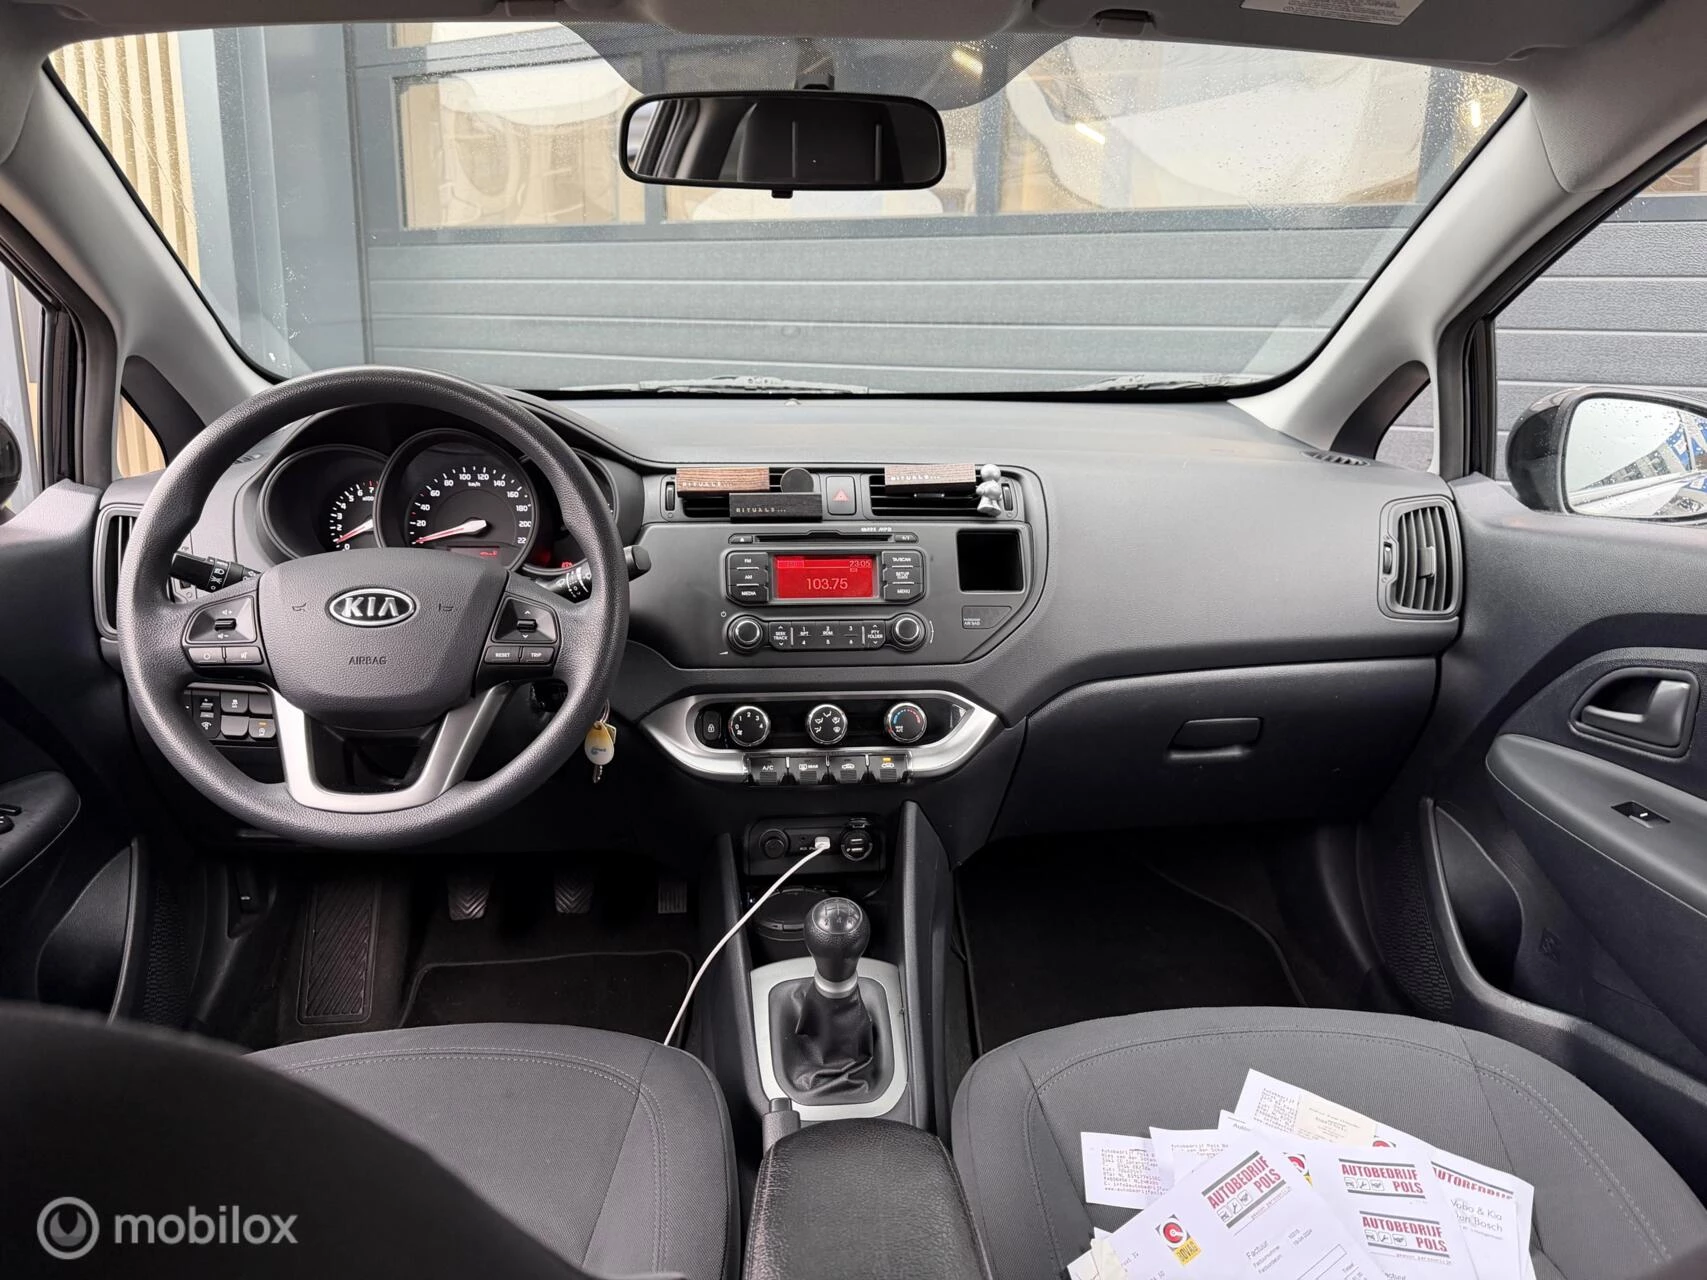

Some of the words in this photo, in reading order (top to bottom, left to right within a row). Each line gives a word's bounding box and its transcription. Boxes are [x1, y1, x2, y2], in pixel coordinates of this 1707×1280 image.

[806, 578, 848, 590] 103.75
[342, 597, 400, 617] KIA
[349, 656, 386, 666] AIRBAG
[1341, 1164, 1416, 1180] AUTOBEDRIJF
[1207, 1156, 1269, 1209] AUTOBEDRIJF
[1253, 1168, 1282, 1193] POLS
[1392, 1180, 1424, 1194] POLS
[1477, 1206, 1484, 1216] &
[1488, 1209, 1502, 1220] Kia
[1362, 1216, 1443, 1238] AUTOBEDRIJF
[1474, 1216, 1503, 1232] Bosch
[1246, 1240, 1268, 1260] Factuur
[1416, 1236, 1448, 1252] POLS
